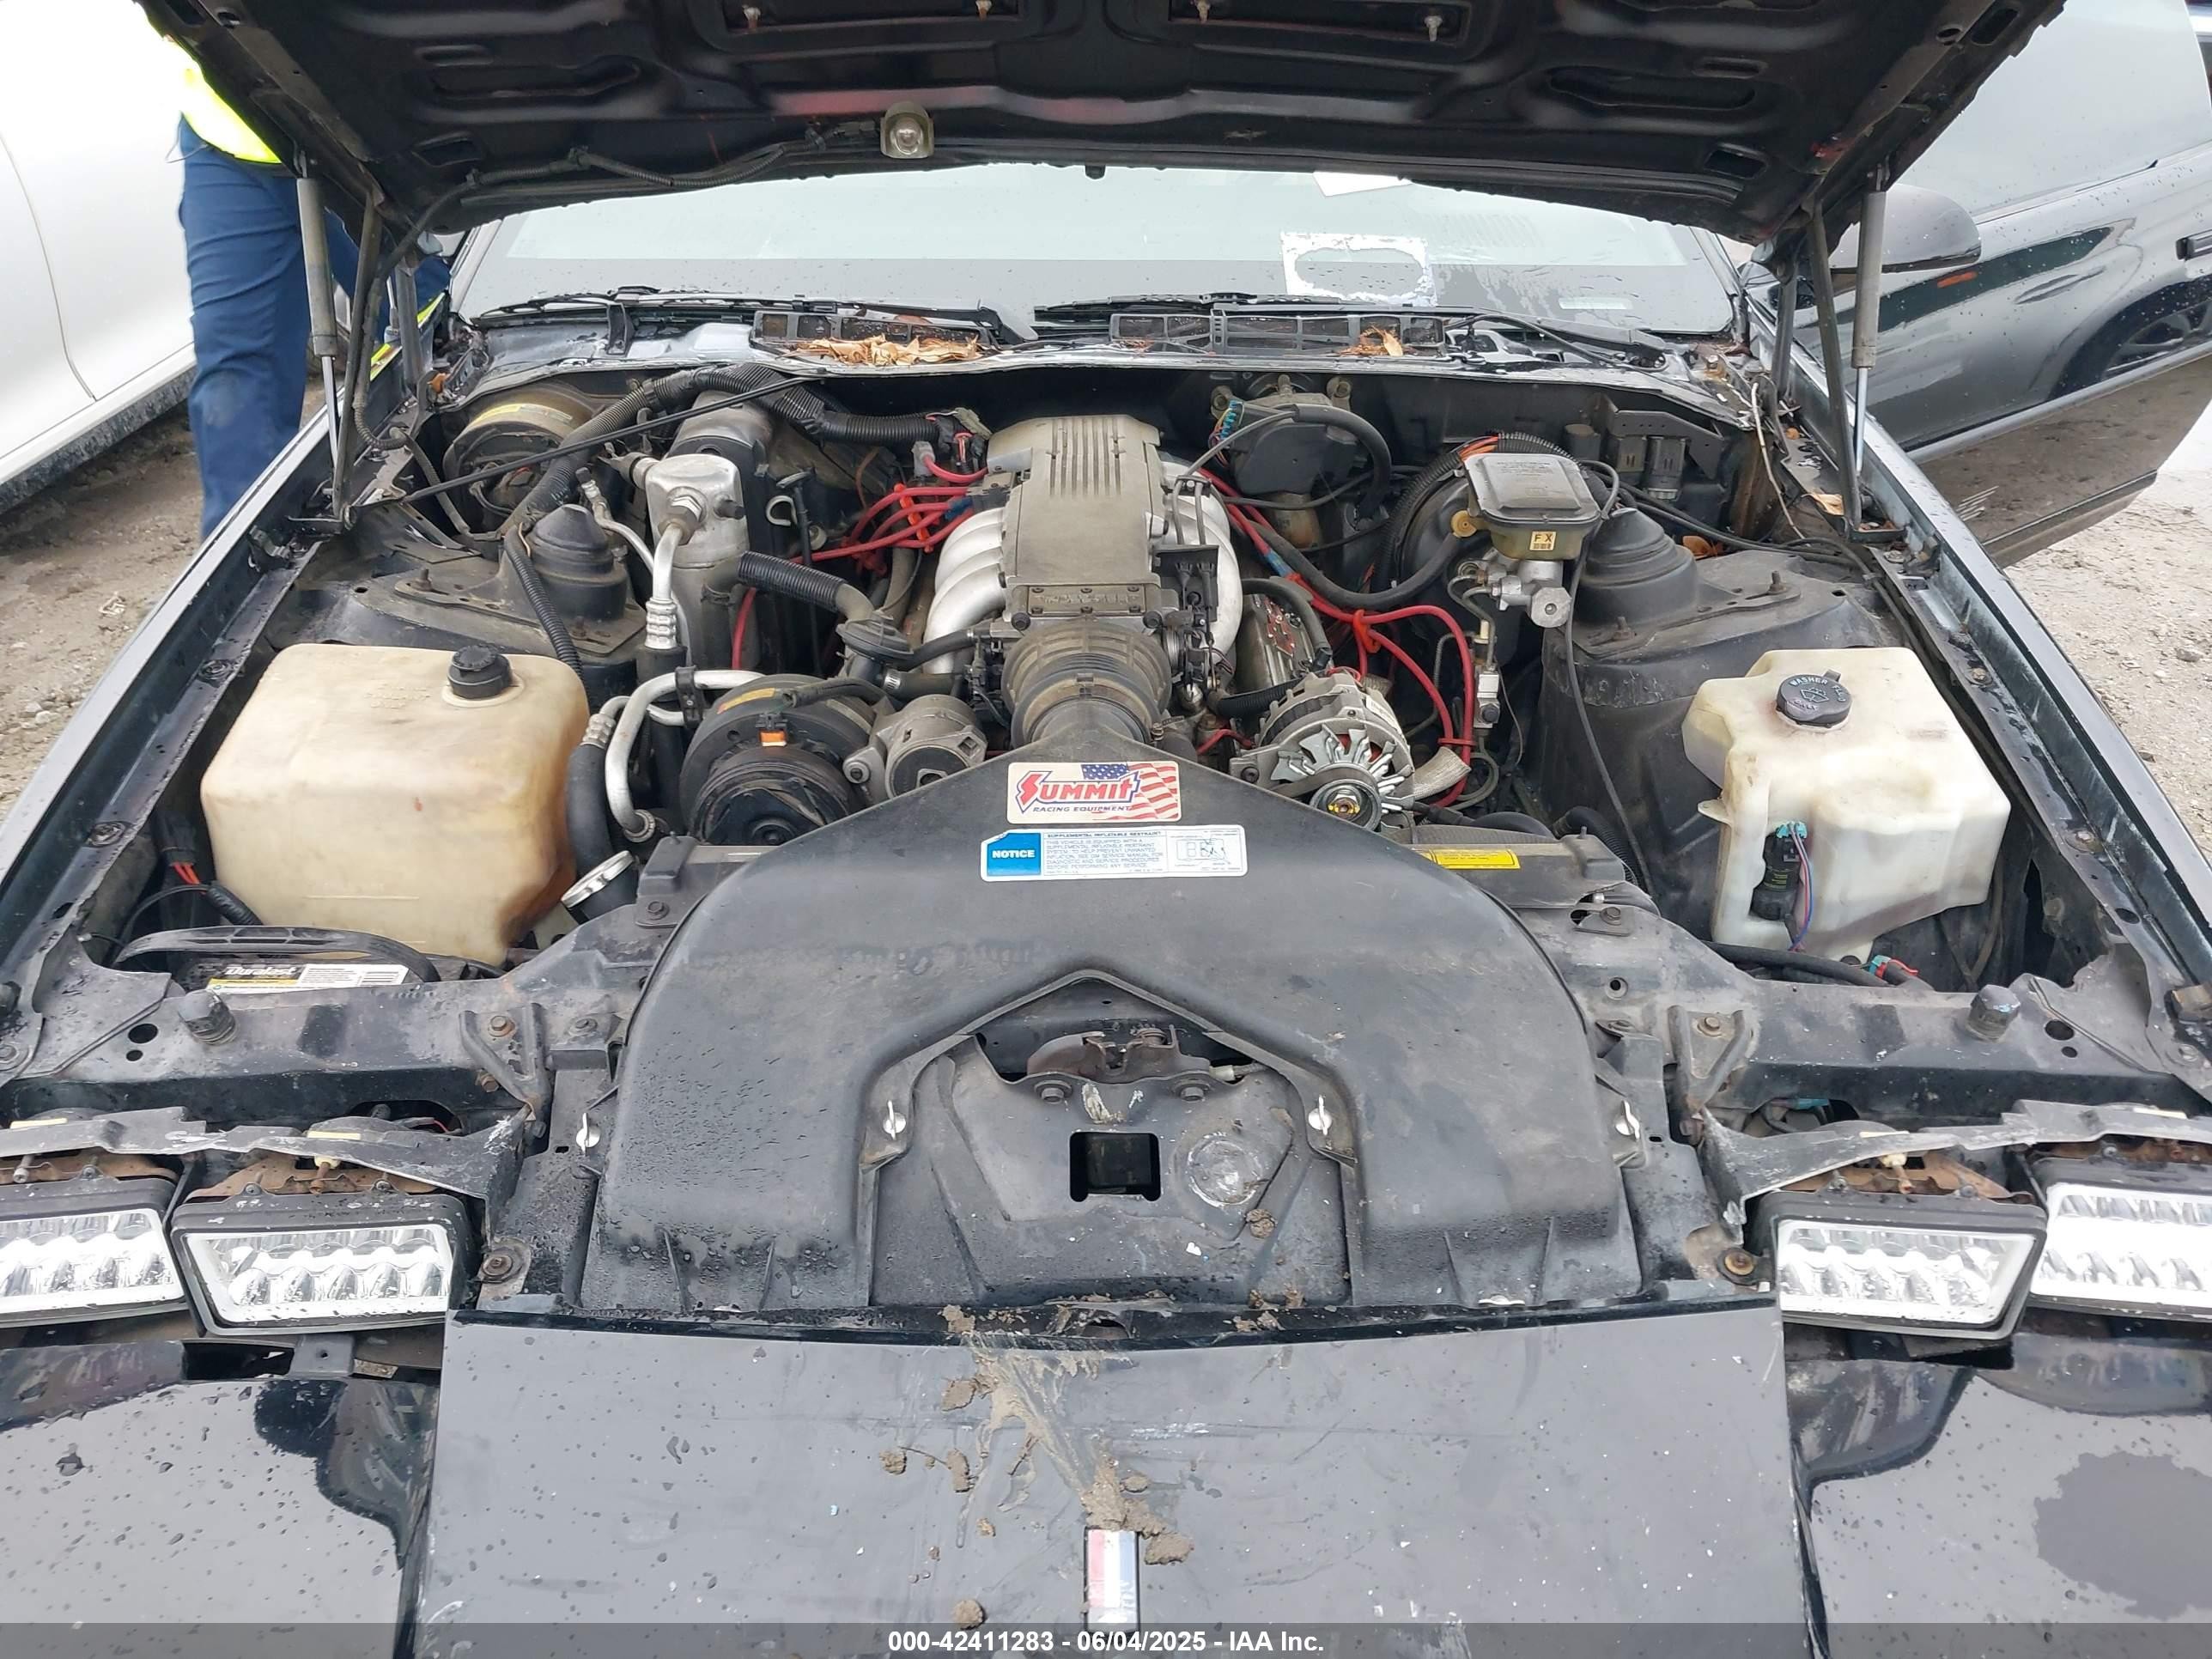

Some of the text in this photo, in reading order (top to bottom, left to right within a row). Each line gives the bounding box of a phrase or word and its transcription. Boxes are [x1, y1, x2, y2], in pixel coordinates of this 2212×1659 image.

[1790, 677, 1828, 686] WASHER
[1831, 685, 1847, 702] FLUID
[992, 849, 1035, 859] NOTICE
[224, 967, 297, 975] Duralast
